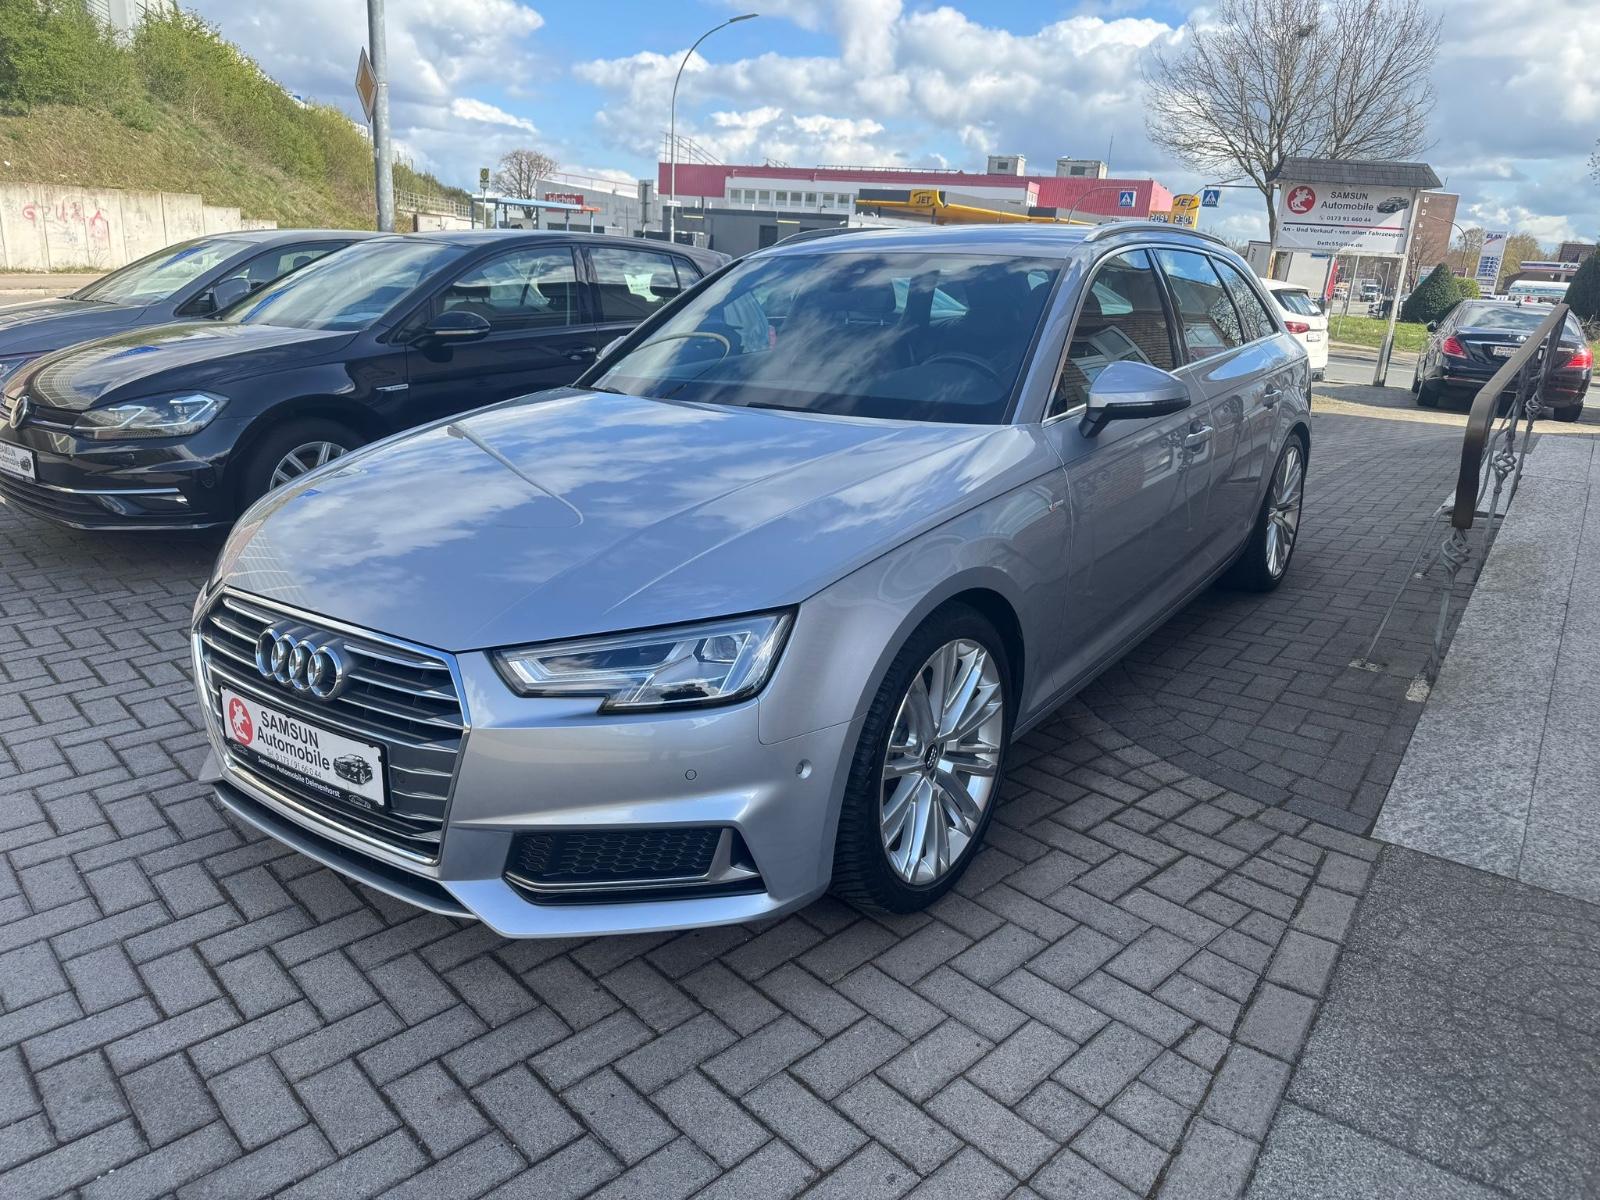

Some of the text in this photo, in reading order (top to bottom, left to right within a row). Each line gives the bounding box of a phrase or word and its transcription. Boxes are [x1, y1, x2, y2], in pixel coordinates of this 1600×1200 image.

[916, 195, 932, 204] JET
[1330, 191, 1369, 200] SAMSUN
[1174, 198, 1195, 207] JET
[1321, 201, 1374, 211] Automobile
[261, 711, 319, 749] SAMSUN
[257, 725, 330, 771] Automobile
[305, 778, 341, 798] Delmenhorst
